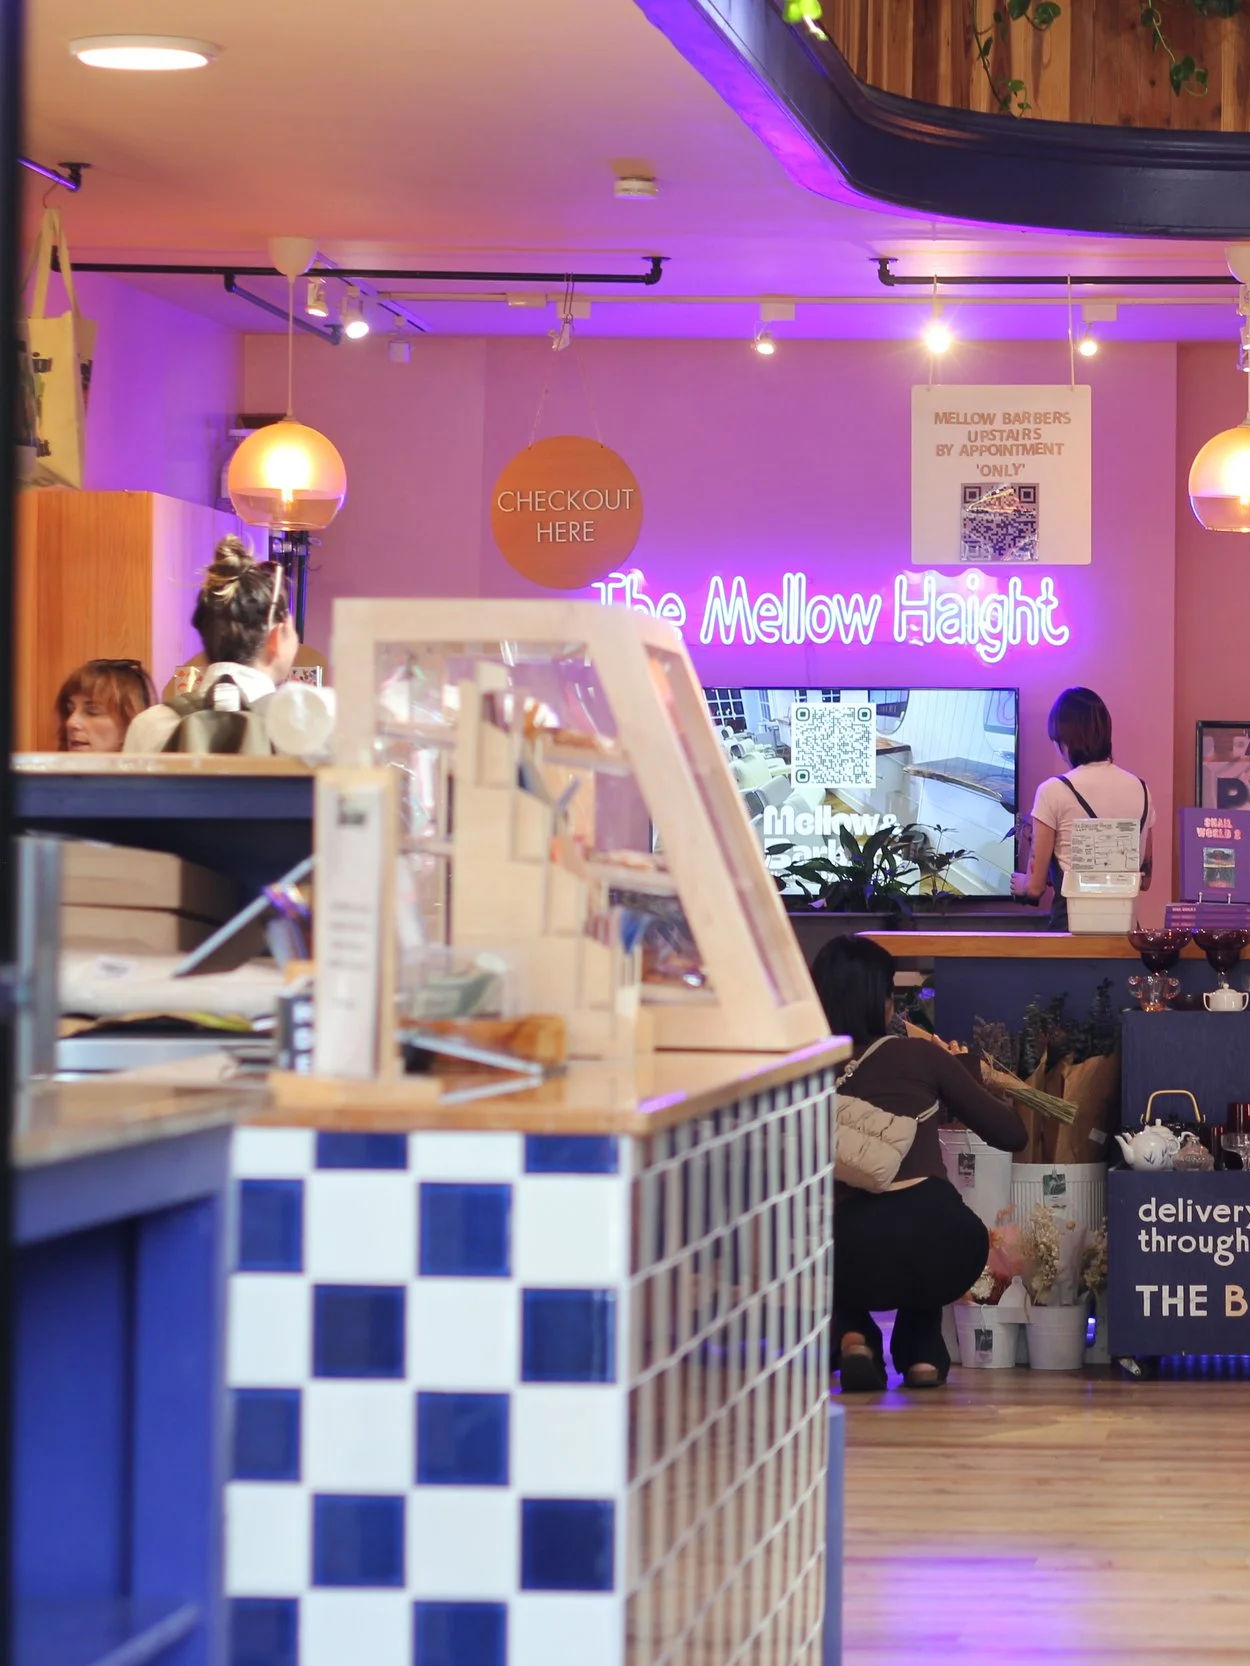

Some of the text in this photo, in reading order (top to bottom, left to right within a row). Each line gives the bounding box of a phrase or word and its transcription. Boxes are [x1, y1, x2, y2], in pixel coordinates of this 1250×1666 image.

[934, 411, 1072, 425] MELLOW BARBERS
[967, 428, 1042, 443] UPSTAIRS
[936, 442, 1065, 457] BY APPOINTMENT
[976, 463, 1025, 477] 'ONLY'
[497, 488, 634, 512] CHECKOUT
[537, 520, 595, 543] HERE
[591, 572, 1070, 664] The Mellow Haight
[763, 804, 881, 836] Mellow
[1203, 817, 1233, 829] SNAIL
[1196, 827, 1232, 839] WORLD
[1135, 1284, 1208, 1317] THE
